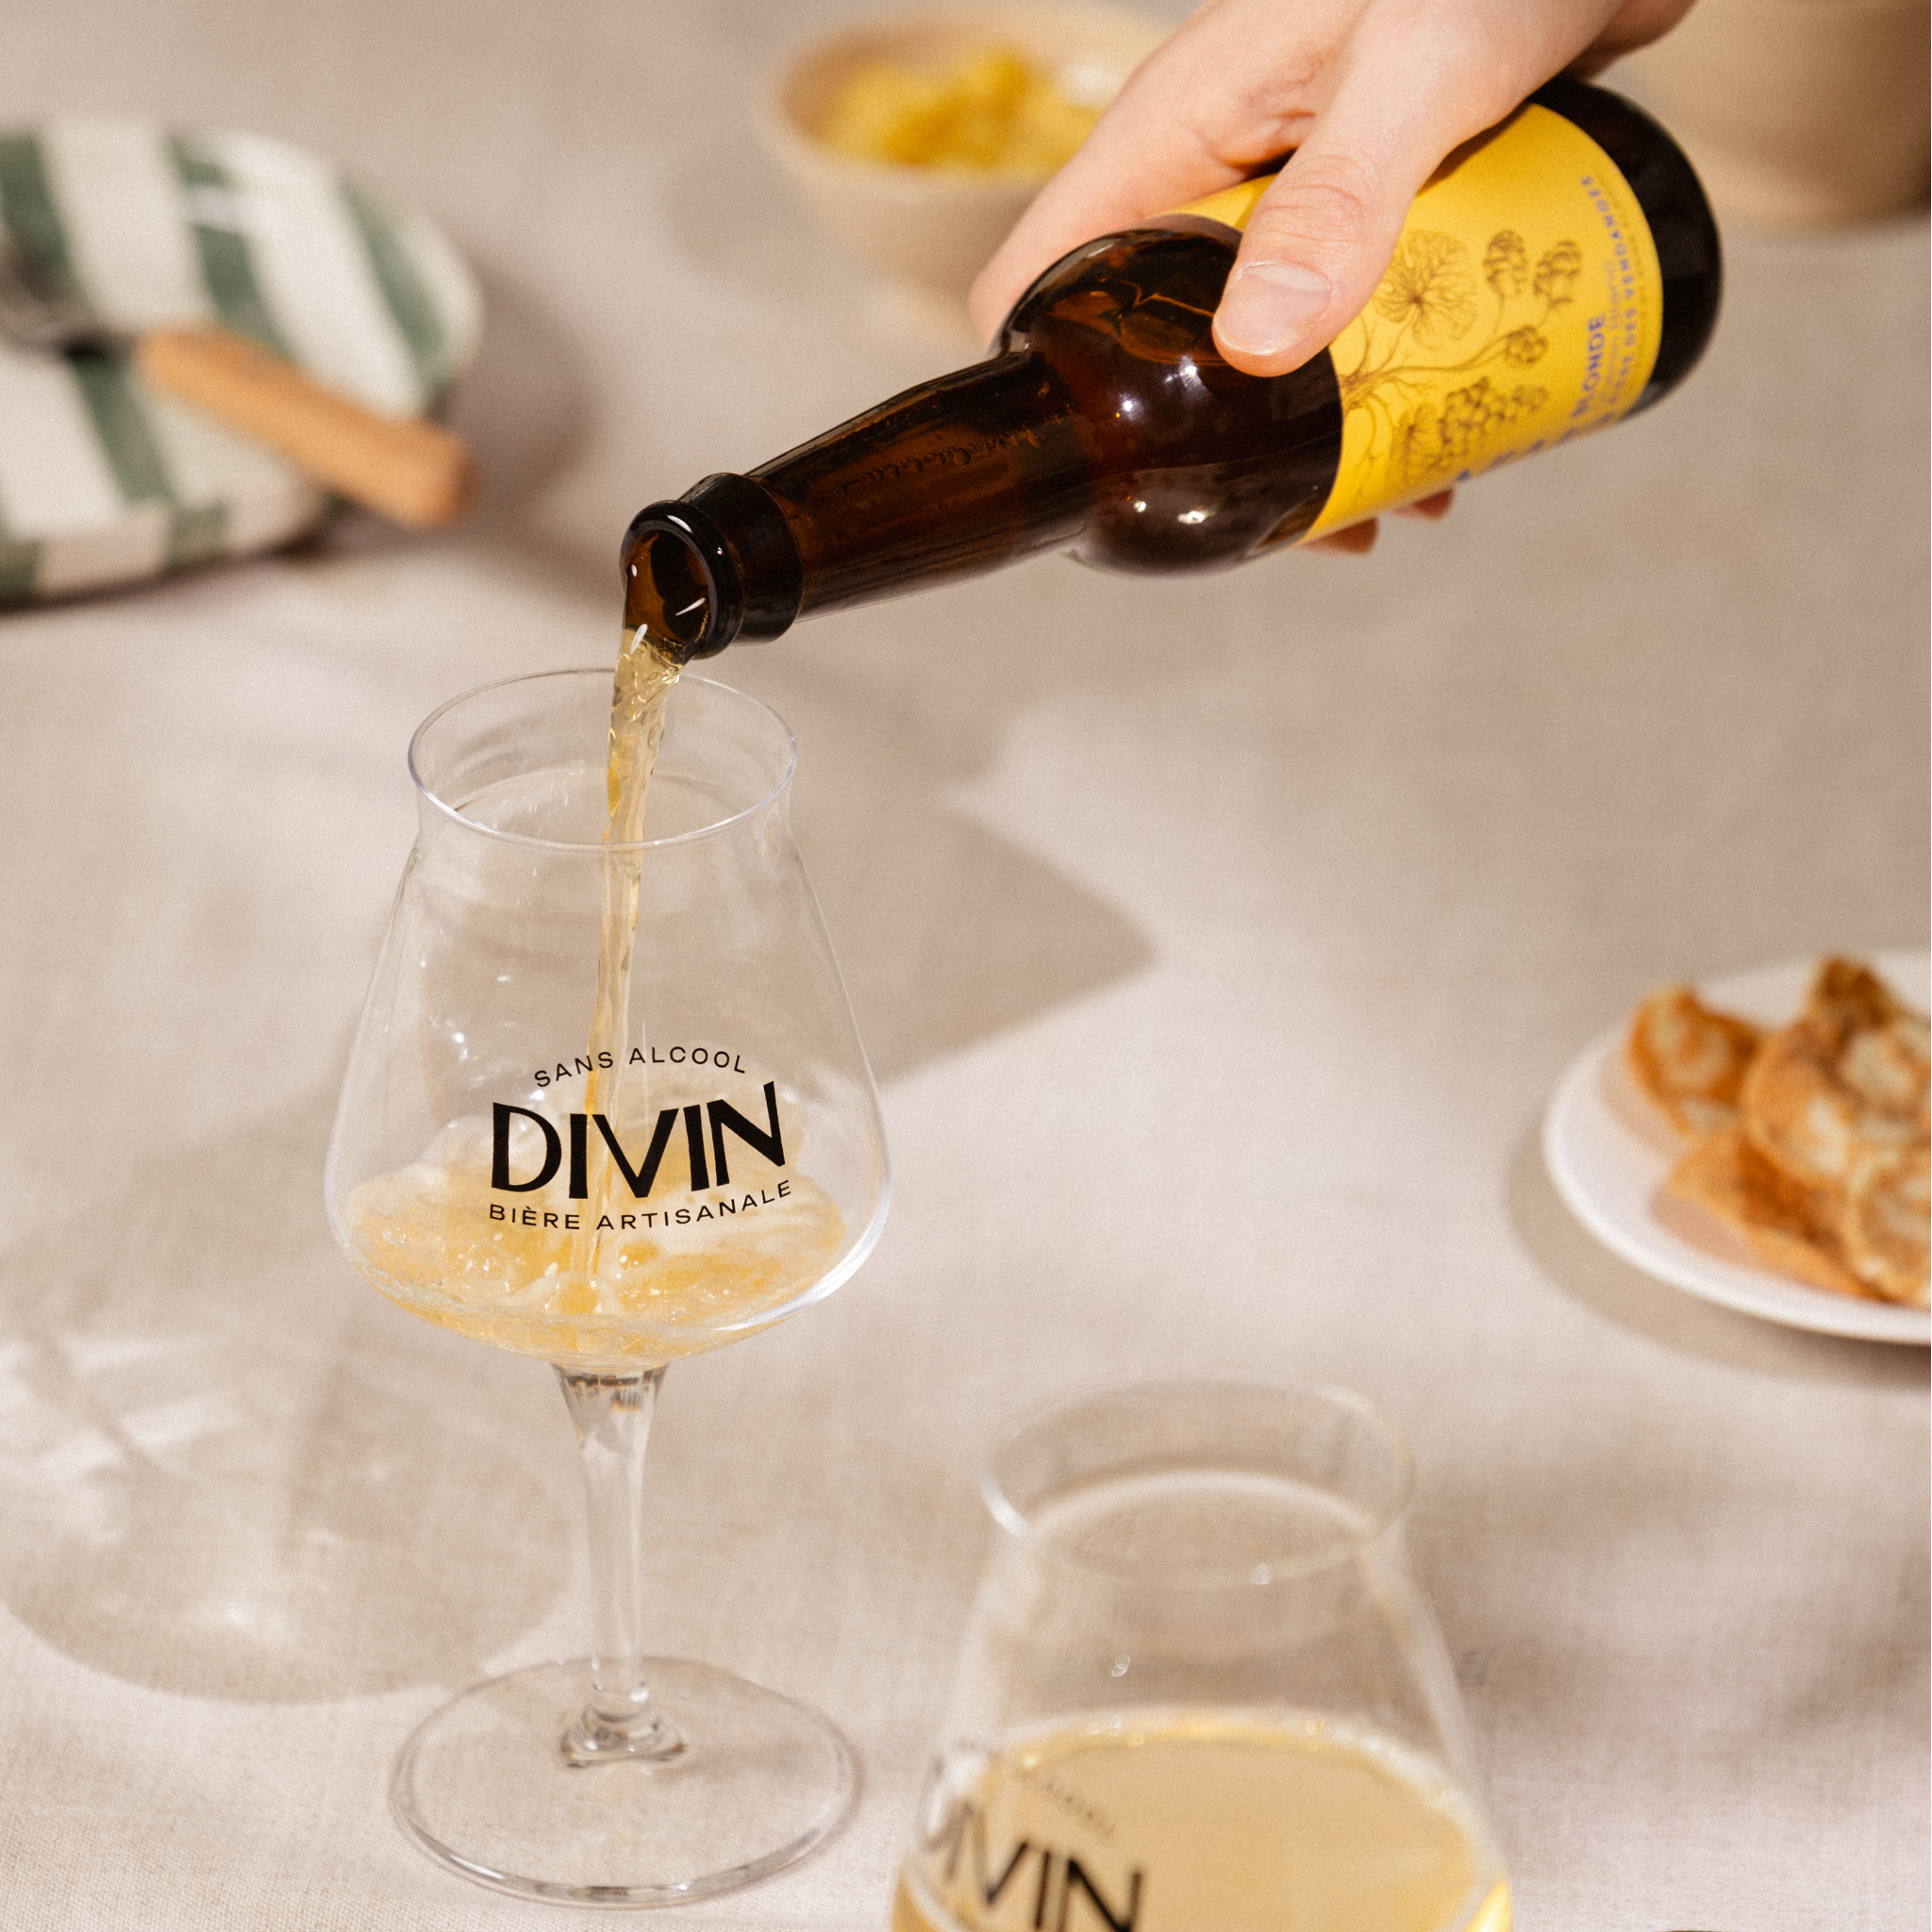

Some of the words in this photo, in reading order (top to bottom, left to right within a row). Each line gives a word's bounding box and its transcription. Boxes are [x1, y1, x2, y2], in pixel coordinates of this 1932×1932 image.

[534, 1051, 614, 1088] SANS
[628, 1045, 746, 1074] ALCOOL
[491, 1080, 786, 1200] DIVIN
[489, 1203, 581, 1230] BIÈRE
[596, 1179, 791, 1230] ARTISANALE
